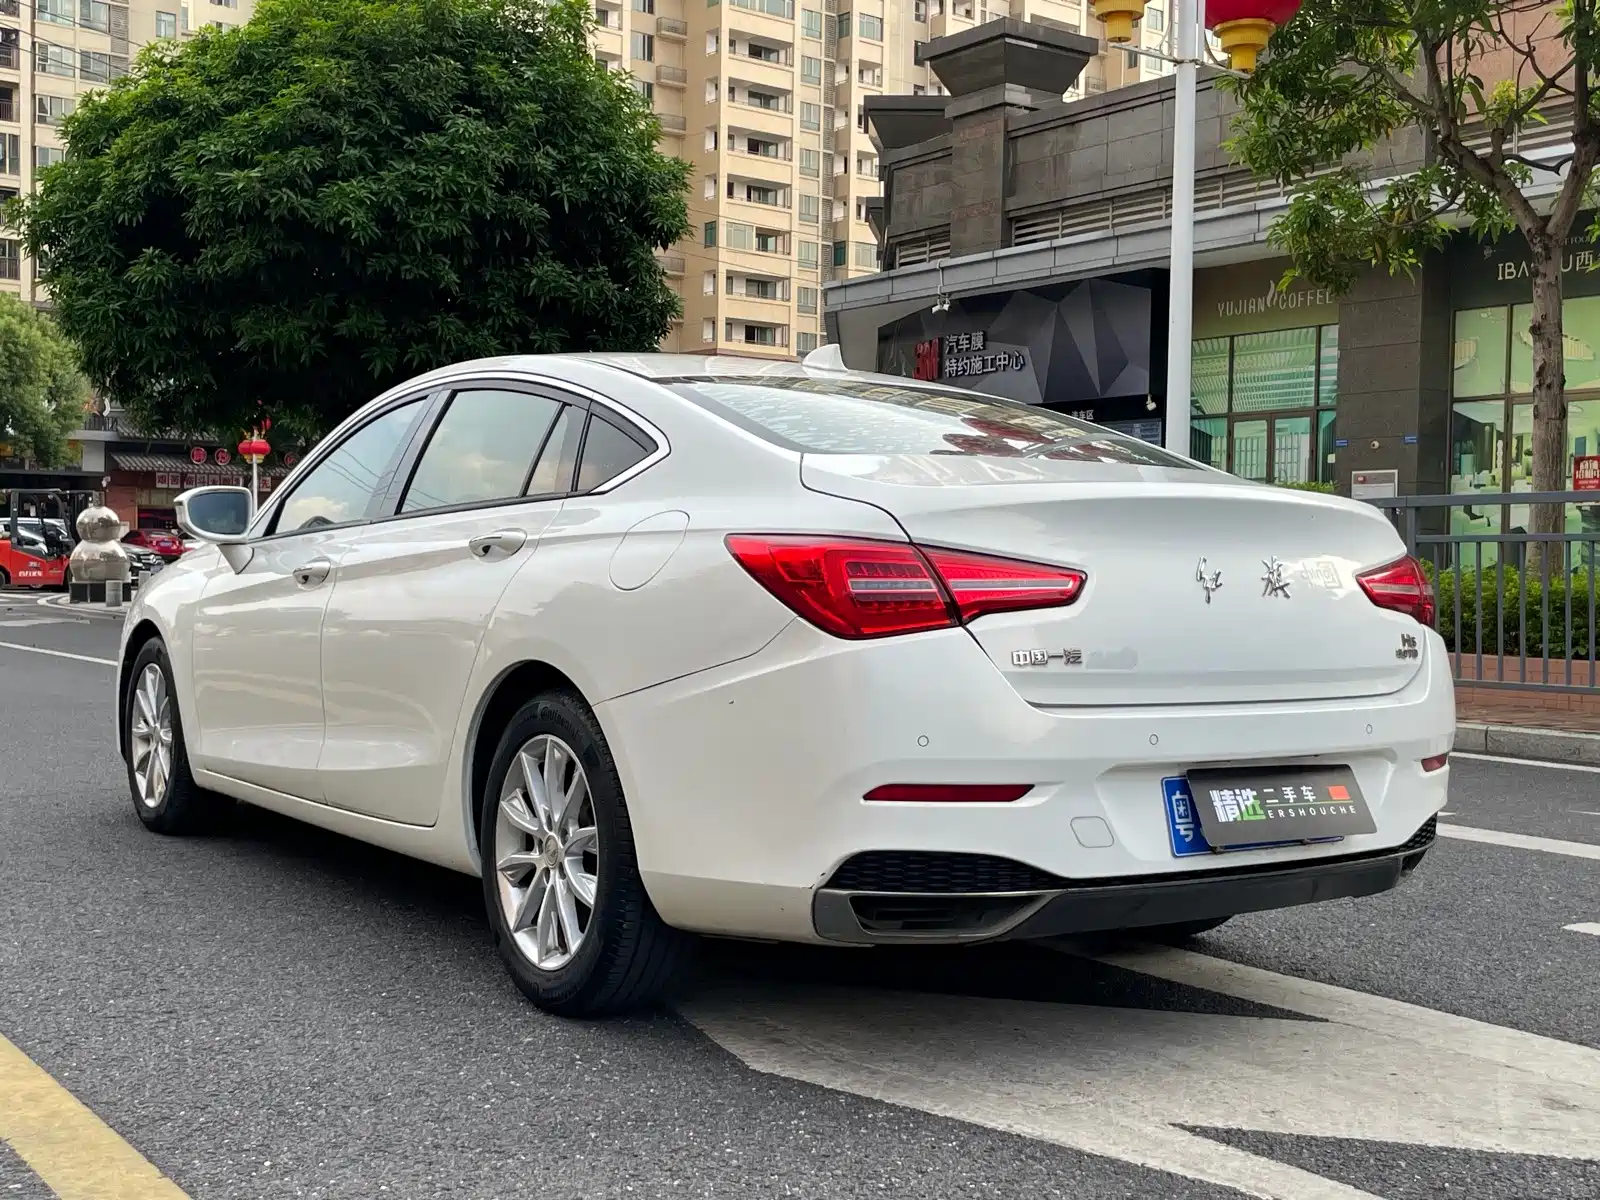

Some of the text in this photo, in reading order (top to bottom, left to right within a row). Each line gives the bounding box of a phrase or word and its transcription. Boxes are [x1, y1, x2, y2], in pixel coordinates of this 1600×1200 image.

[1498, 253, 1573, 281] IBAU
[1576, 250, 1600, 272] 西
[1217, 296, 1266, 317] YUJIAN
[945, 331, 984, 353] 汽车膜
[911, 336, 939, 381] 3M
[944, 351, 1024, 377] 特约施工中心
[1011, 648, 1083, 667] 中国一汽
[1263, 785, 1317, 803] 二手车
[1172, 790, 1195, 842] 粤
[1268, 804, 1357, 819] ERSHOUCHE
